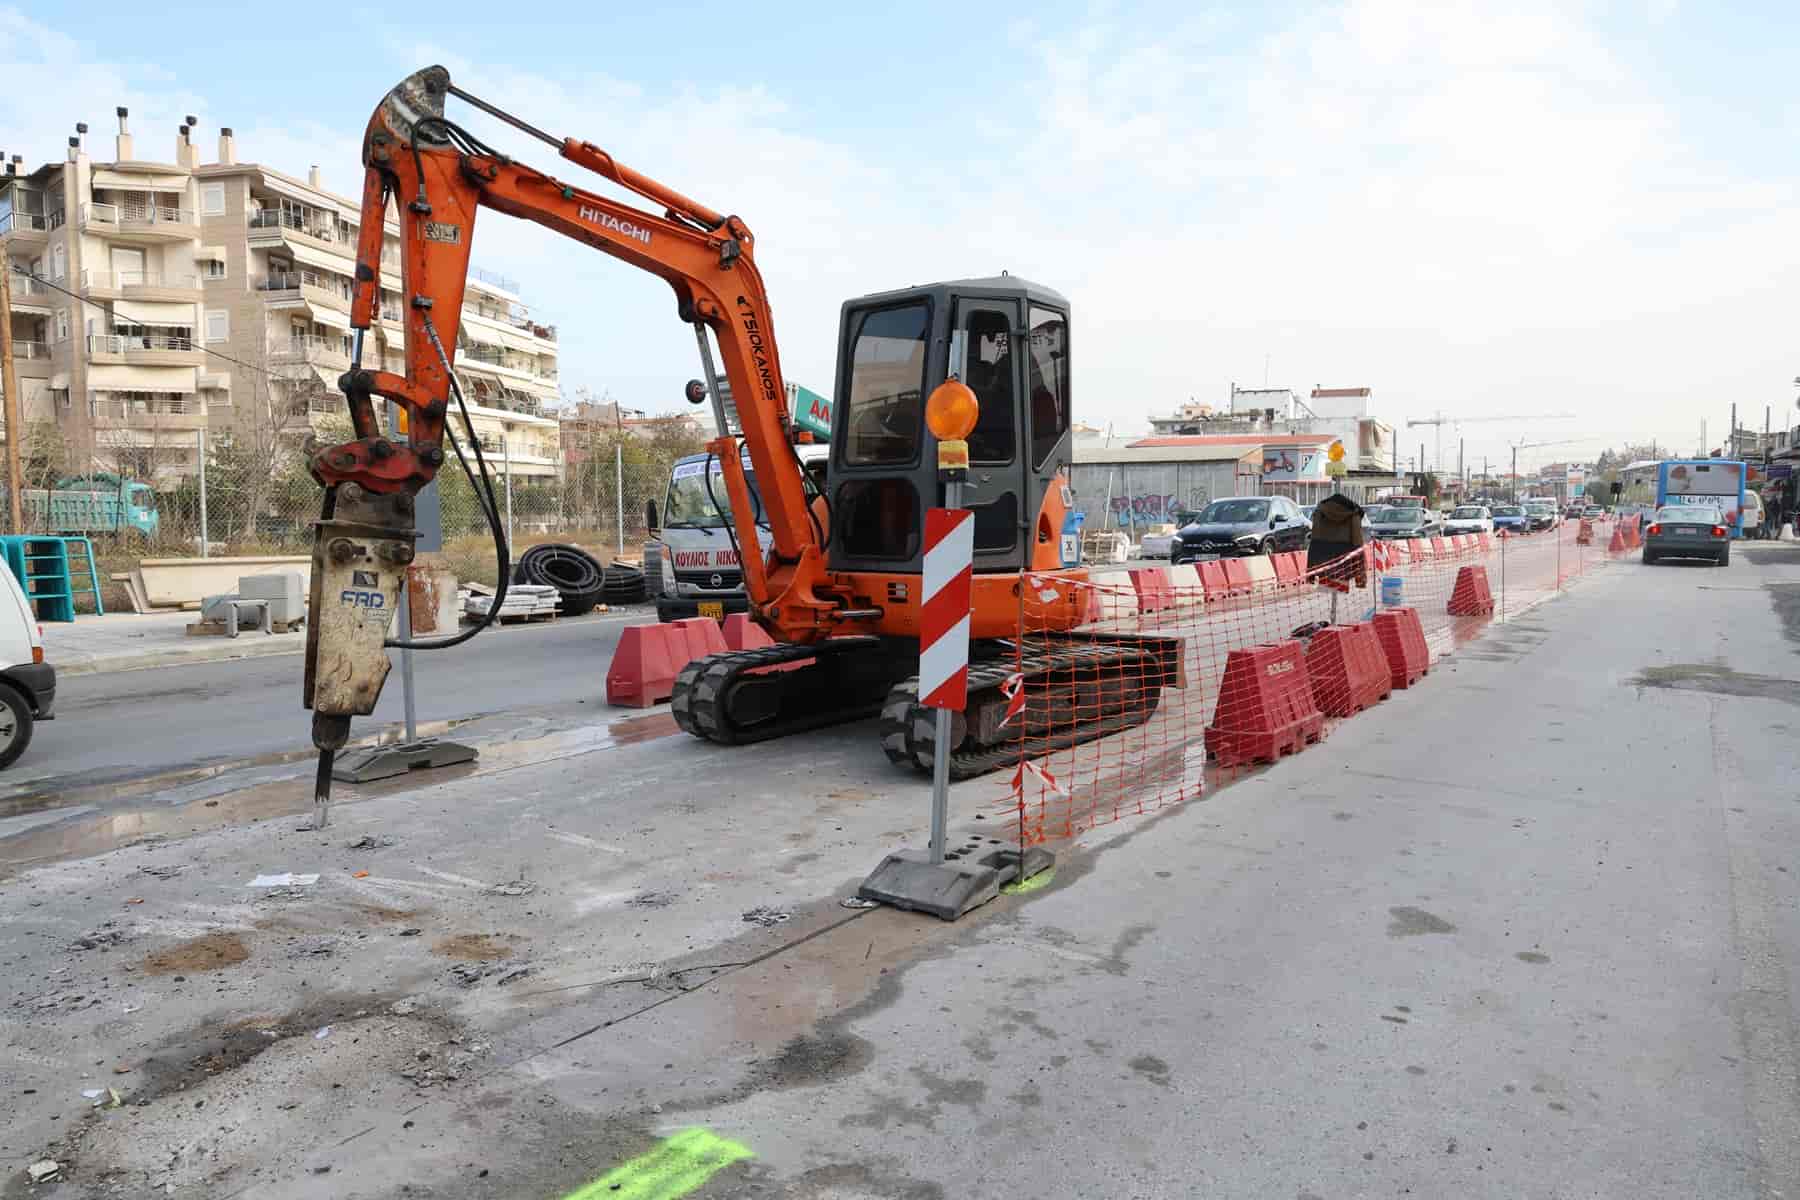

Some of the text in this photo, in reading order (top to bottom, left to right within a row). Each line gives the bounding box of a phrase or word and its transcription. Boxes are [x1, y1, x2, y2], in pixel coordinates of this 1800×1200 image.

[580, 205, 651, 243] HITACHI
[741, 310, 777, 401] TSIOKANOS
[716, 550, 738, 566] ΝΙΚΟ
[341, 590, 385, 609] FRD
